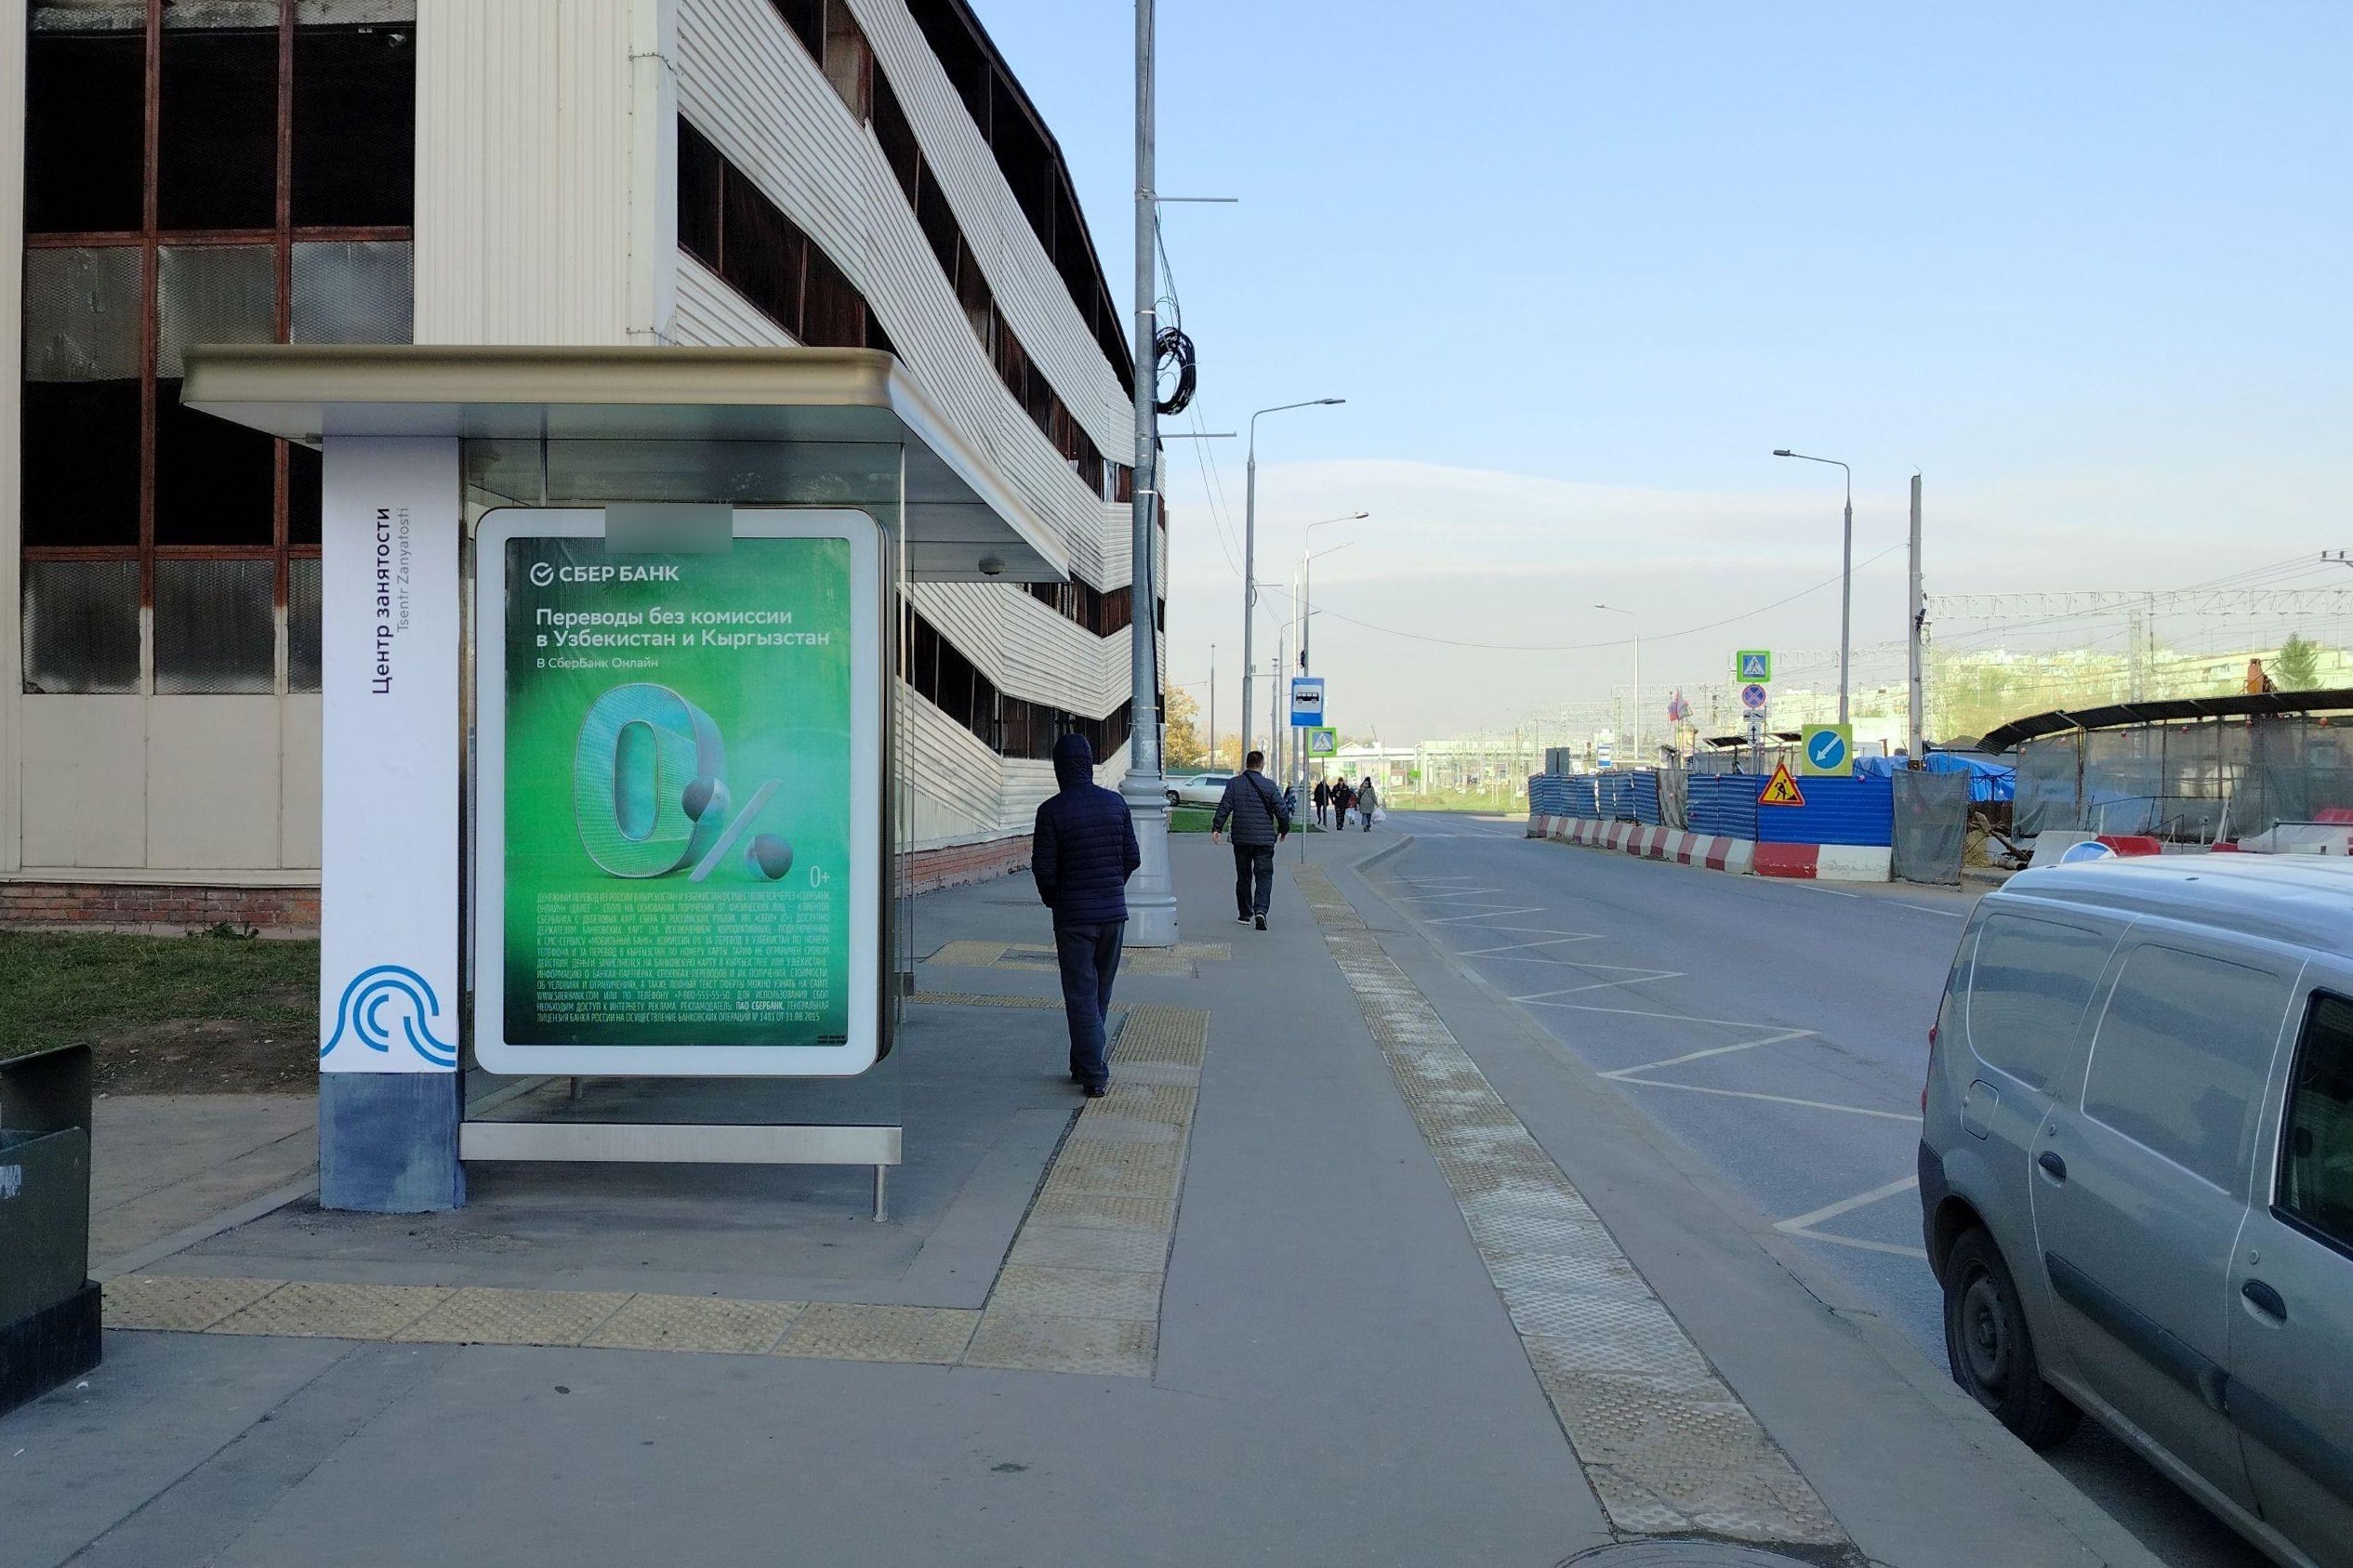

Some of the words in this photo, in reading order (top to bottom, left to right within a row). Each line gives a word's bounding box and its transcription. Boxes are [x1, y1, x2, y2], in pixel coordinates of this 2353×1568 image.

[397, 507, 412, 583] Zanyatosti
[377, 508, 390, 618] занятости
[397, 588, 409, 632] Tsentr
[536, 608, 642, 629] Переводы
[650, 606, 684, 626] без
[691, 612, 792, 625] комиссии
[536, 635, 548, 647] в
[553, 628, 676, 647] Узбекистан
[682, 633, 694, 646] и
[701, 629, 829, 650] Кыргызстан
[372, 625, 393, 693] Центр
[536, 658, 546, 668] В
[549, 657, 609, 670] СберБанк
[612, 657, 658, 668] Онлайн
[810, 865, 830, 888] 0+
[735, 1001, 749, 1010] ПАО
